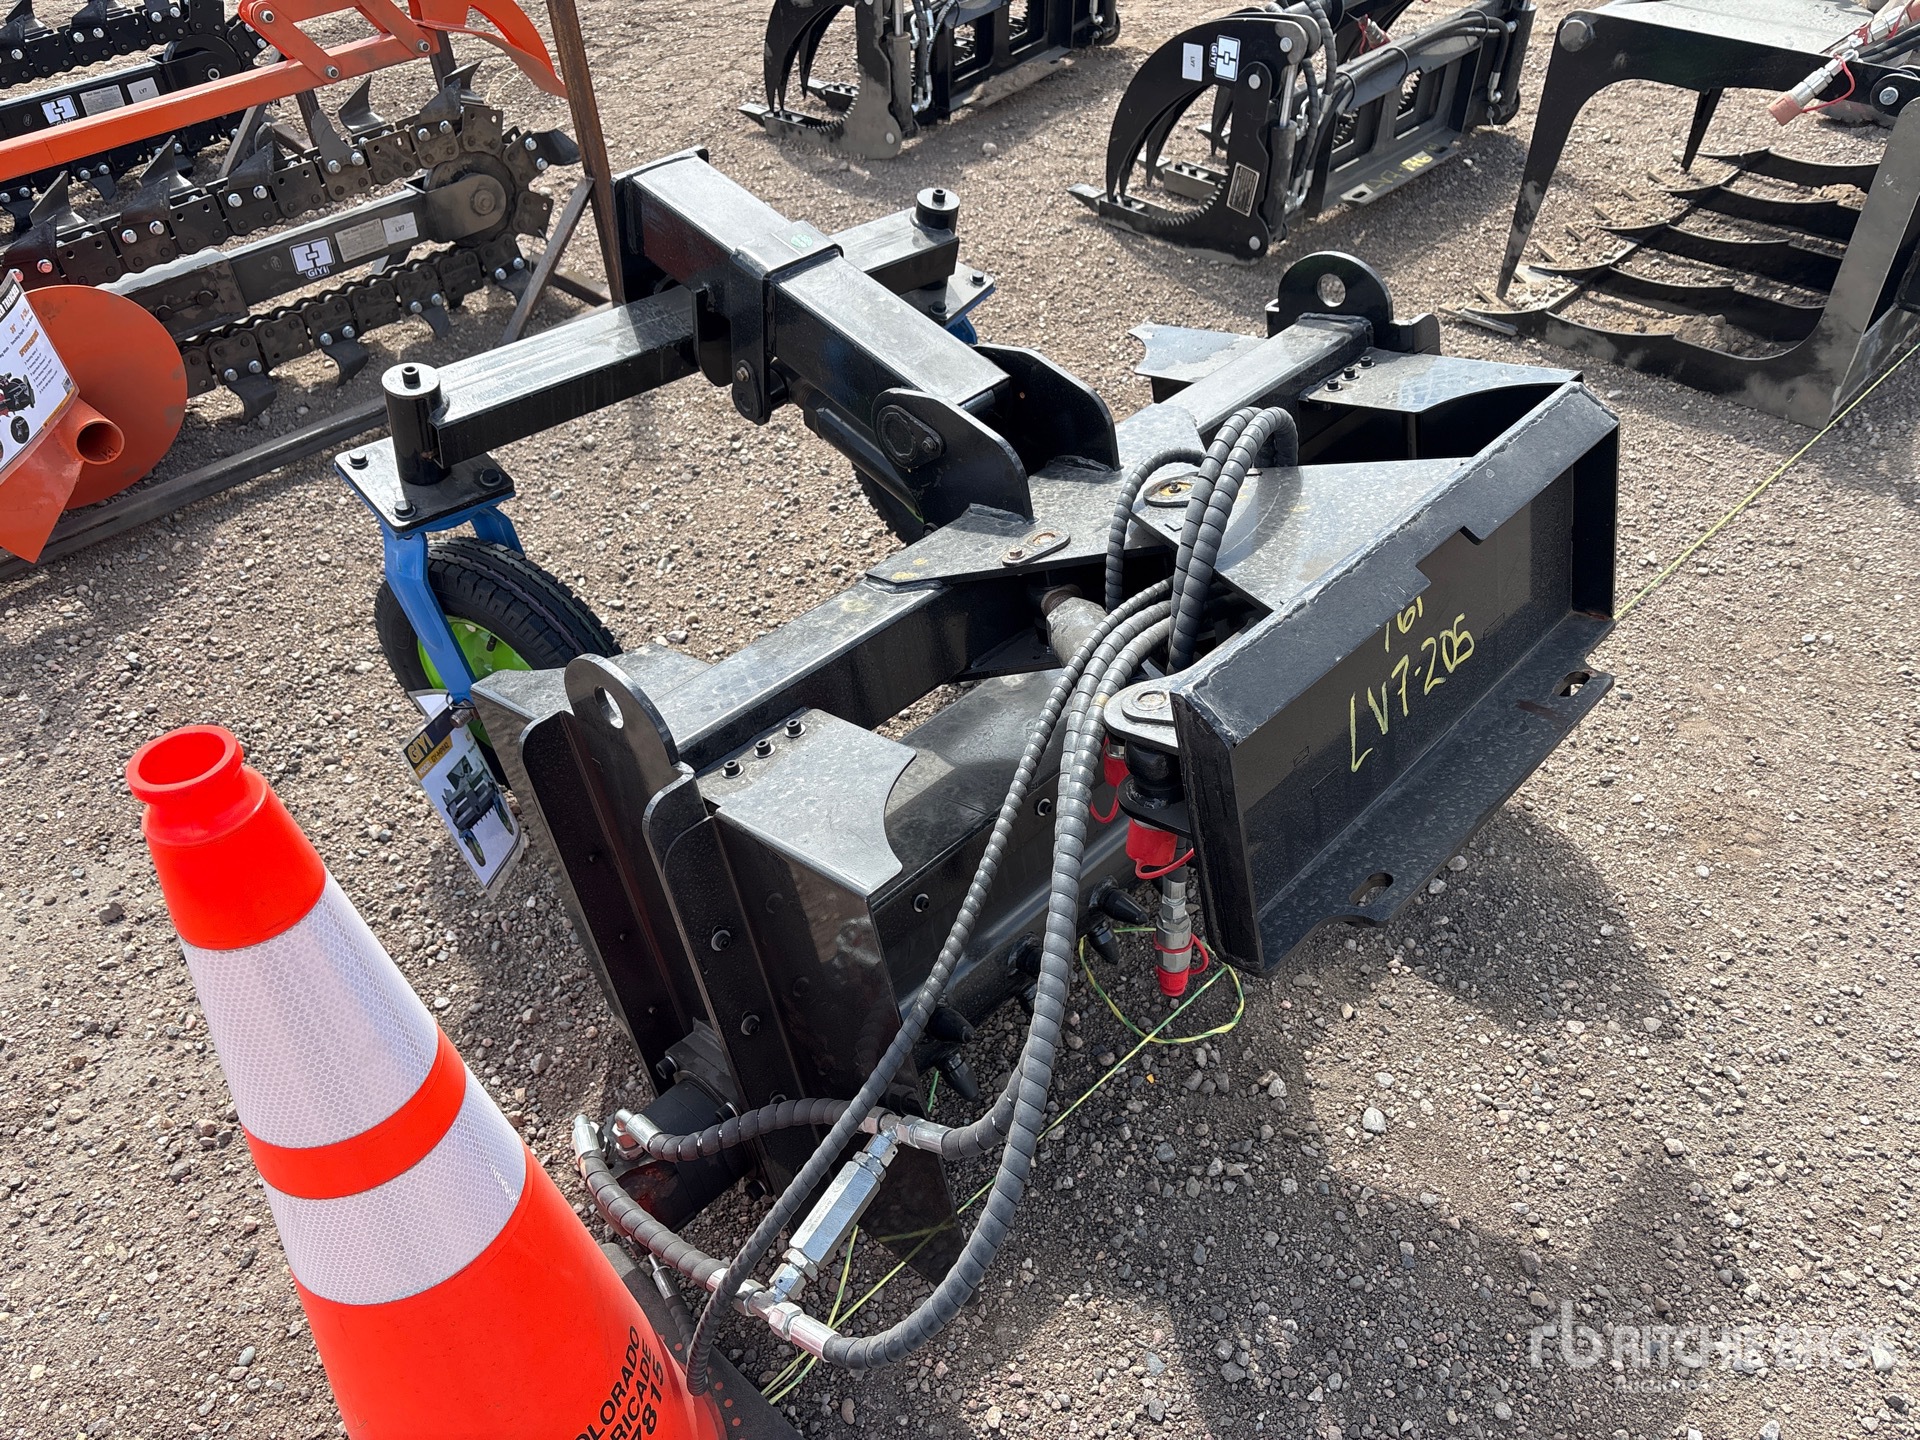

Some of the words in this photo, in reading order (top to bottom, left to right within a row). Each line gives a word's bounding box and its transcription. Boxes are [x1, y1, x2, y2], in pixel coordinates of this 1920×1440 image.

[1209, 45, 1218, 67] GIYI
[395, 224, 406, 233] LV7
[307, 266, 328, 278] GIYI
[1350, 612, 1476, 773] LV7-205
[407, 731, 435, 764] GIYI
[575, 1325, 640, 1440] LORADO
